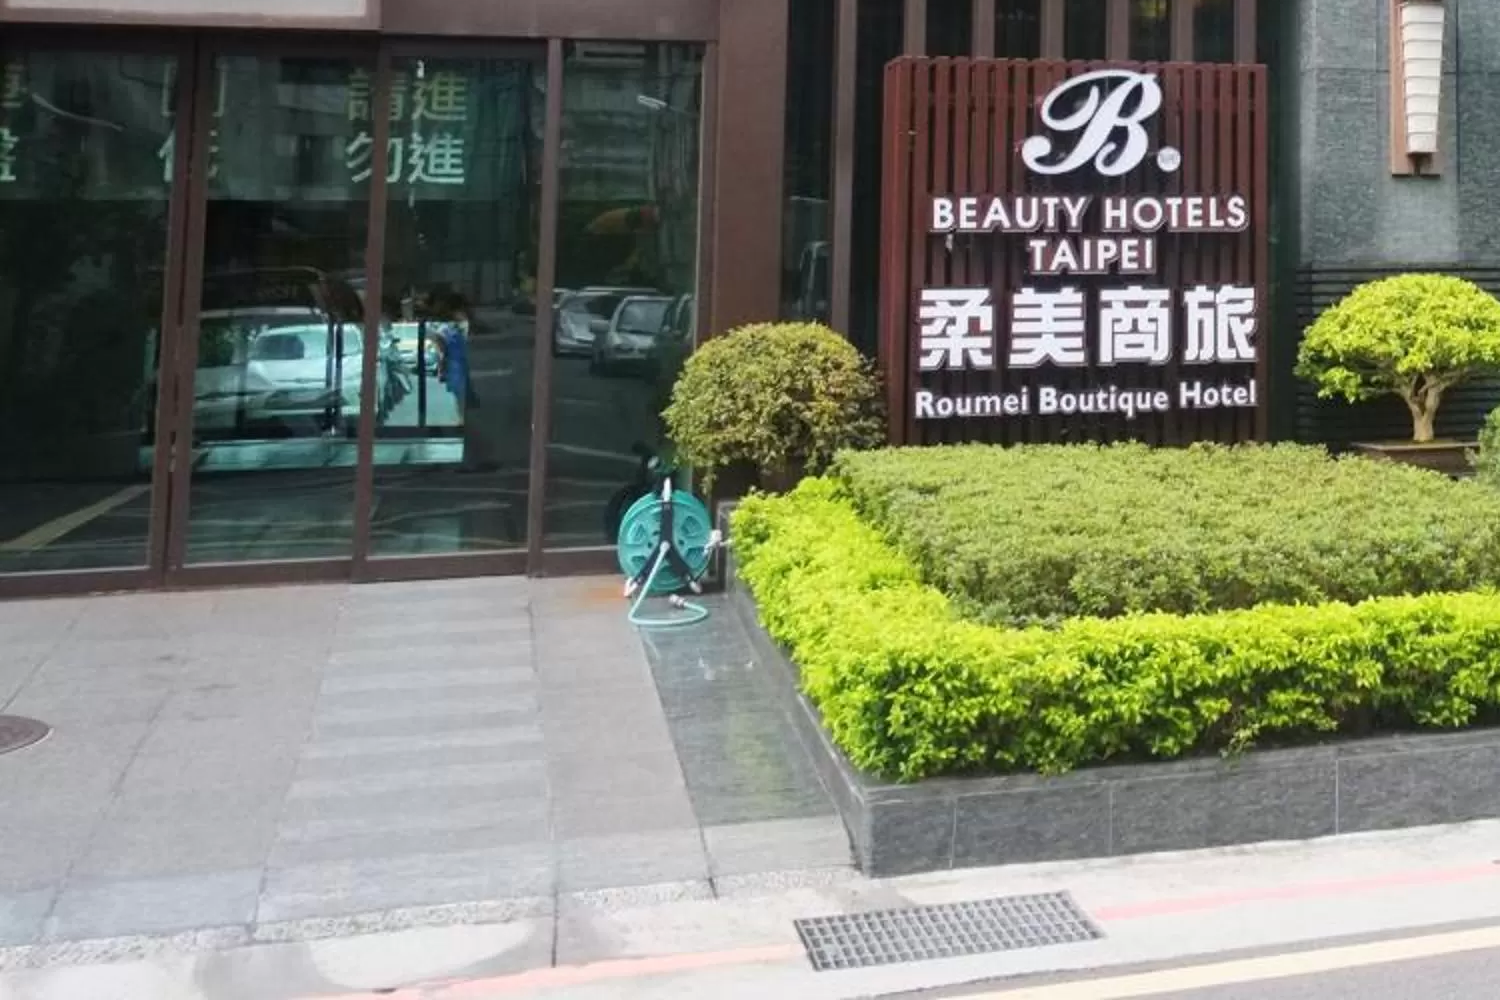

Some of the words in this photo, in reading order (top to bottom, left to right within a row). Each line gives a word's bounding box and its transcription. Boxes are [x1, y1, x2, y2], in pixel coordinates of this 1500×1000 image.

[931, 196, 1088, 231] BEAUTY
[1104, 196, 1248, 229] HOTELS
[1029, 238, 1155, 271] TAIPEI
[918, 285, 1257, 369] 柔美商旅
[914, 386, 1029, 418] Roumei
[1038, 384, 1170, 418] Boutique
[1179, 380, 1258, 408] Hotel
